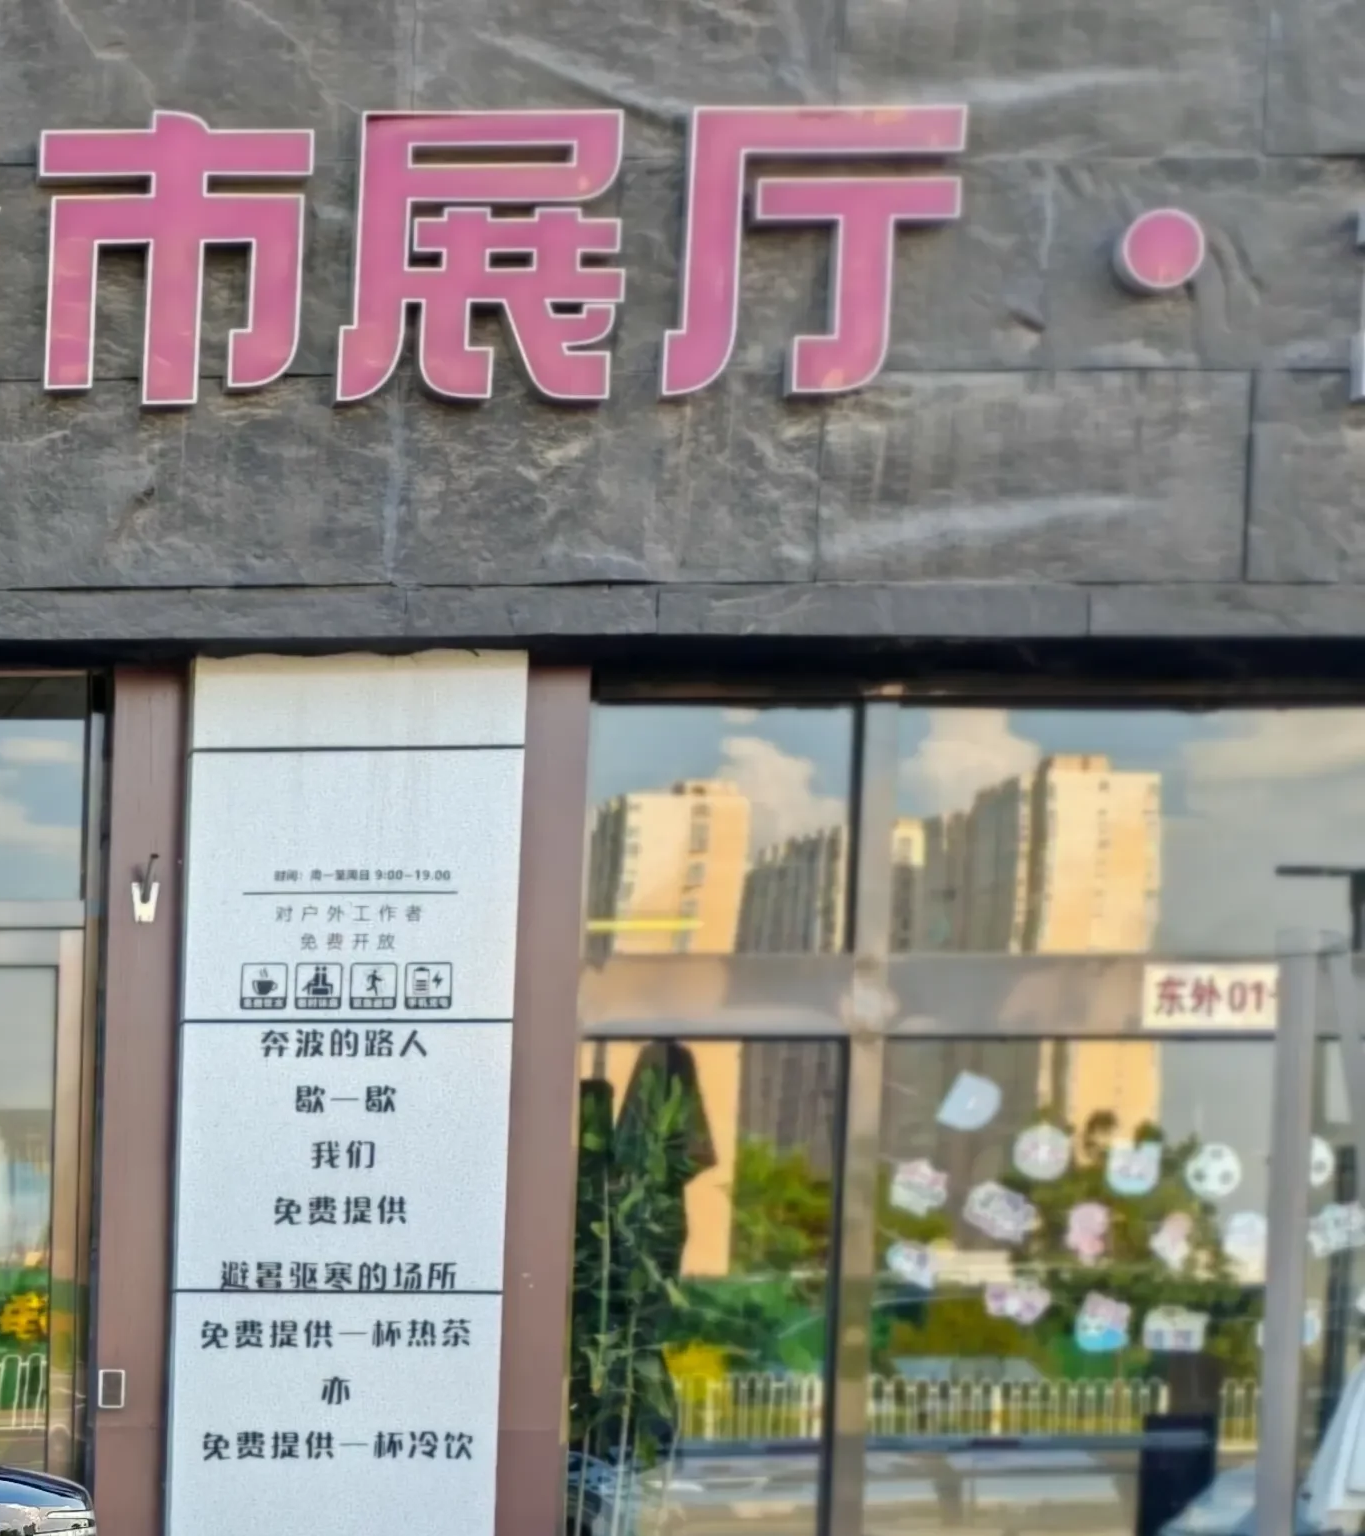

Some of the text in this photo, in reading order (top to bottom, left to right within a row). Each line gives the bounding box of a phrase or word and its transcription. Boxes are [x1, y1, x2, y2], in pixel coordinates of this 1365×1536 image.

[275, 904, 423, 923] 对户外工作者
[300, 932, 396, 951] 免费开放
[1154, 974, 1277, 1017] 东外01
[260, 1029, 428, 1058] 奔波的路人
[295, 1084, 397, 1114] 歇一歇
[311, 1140, 376, 1169] 我们
[273, 1195, 407, 1226] 免费提供
[220, 1261, 458, 1291] 避暑驱寒的场所
[200, 1318, 472, 1350] 免费提供一杯热茶
[321, 1375, 351, 1406] 亦
[202, 1430, 474, 1461] 免费提供一杯冷饮
